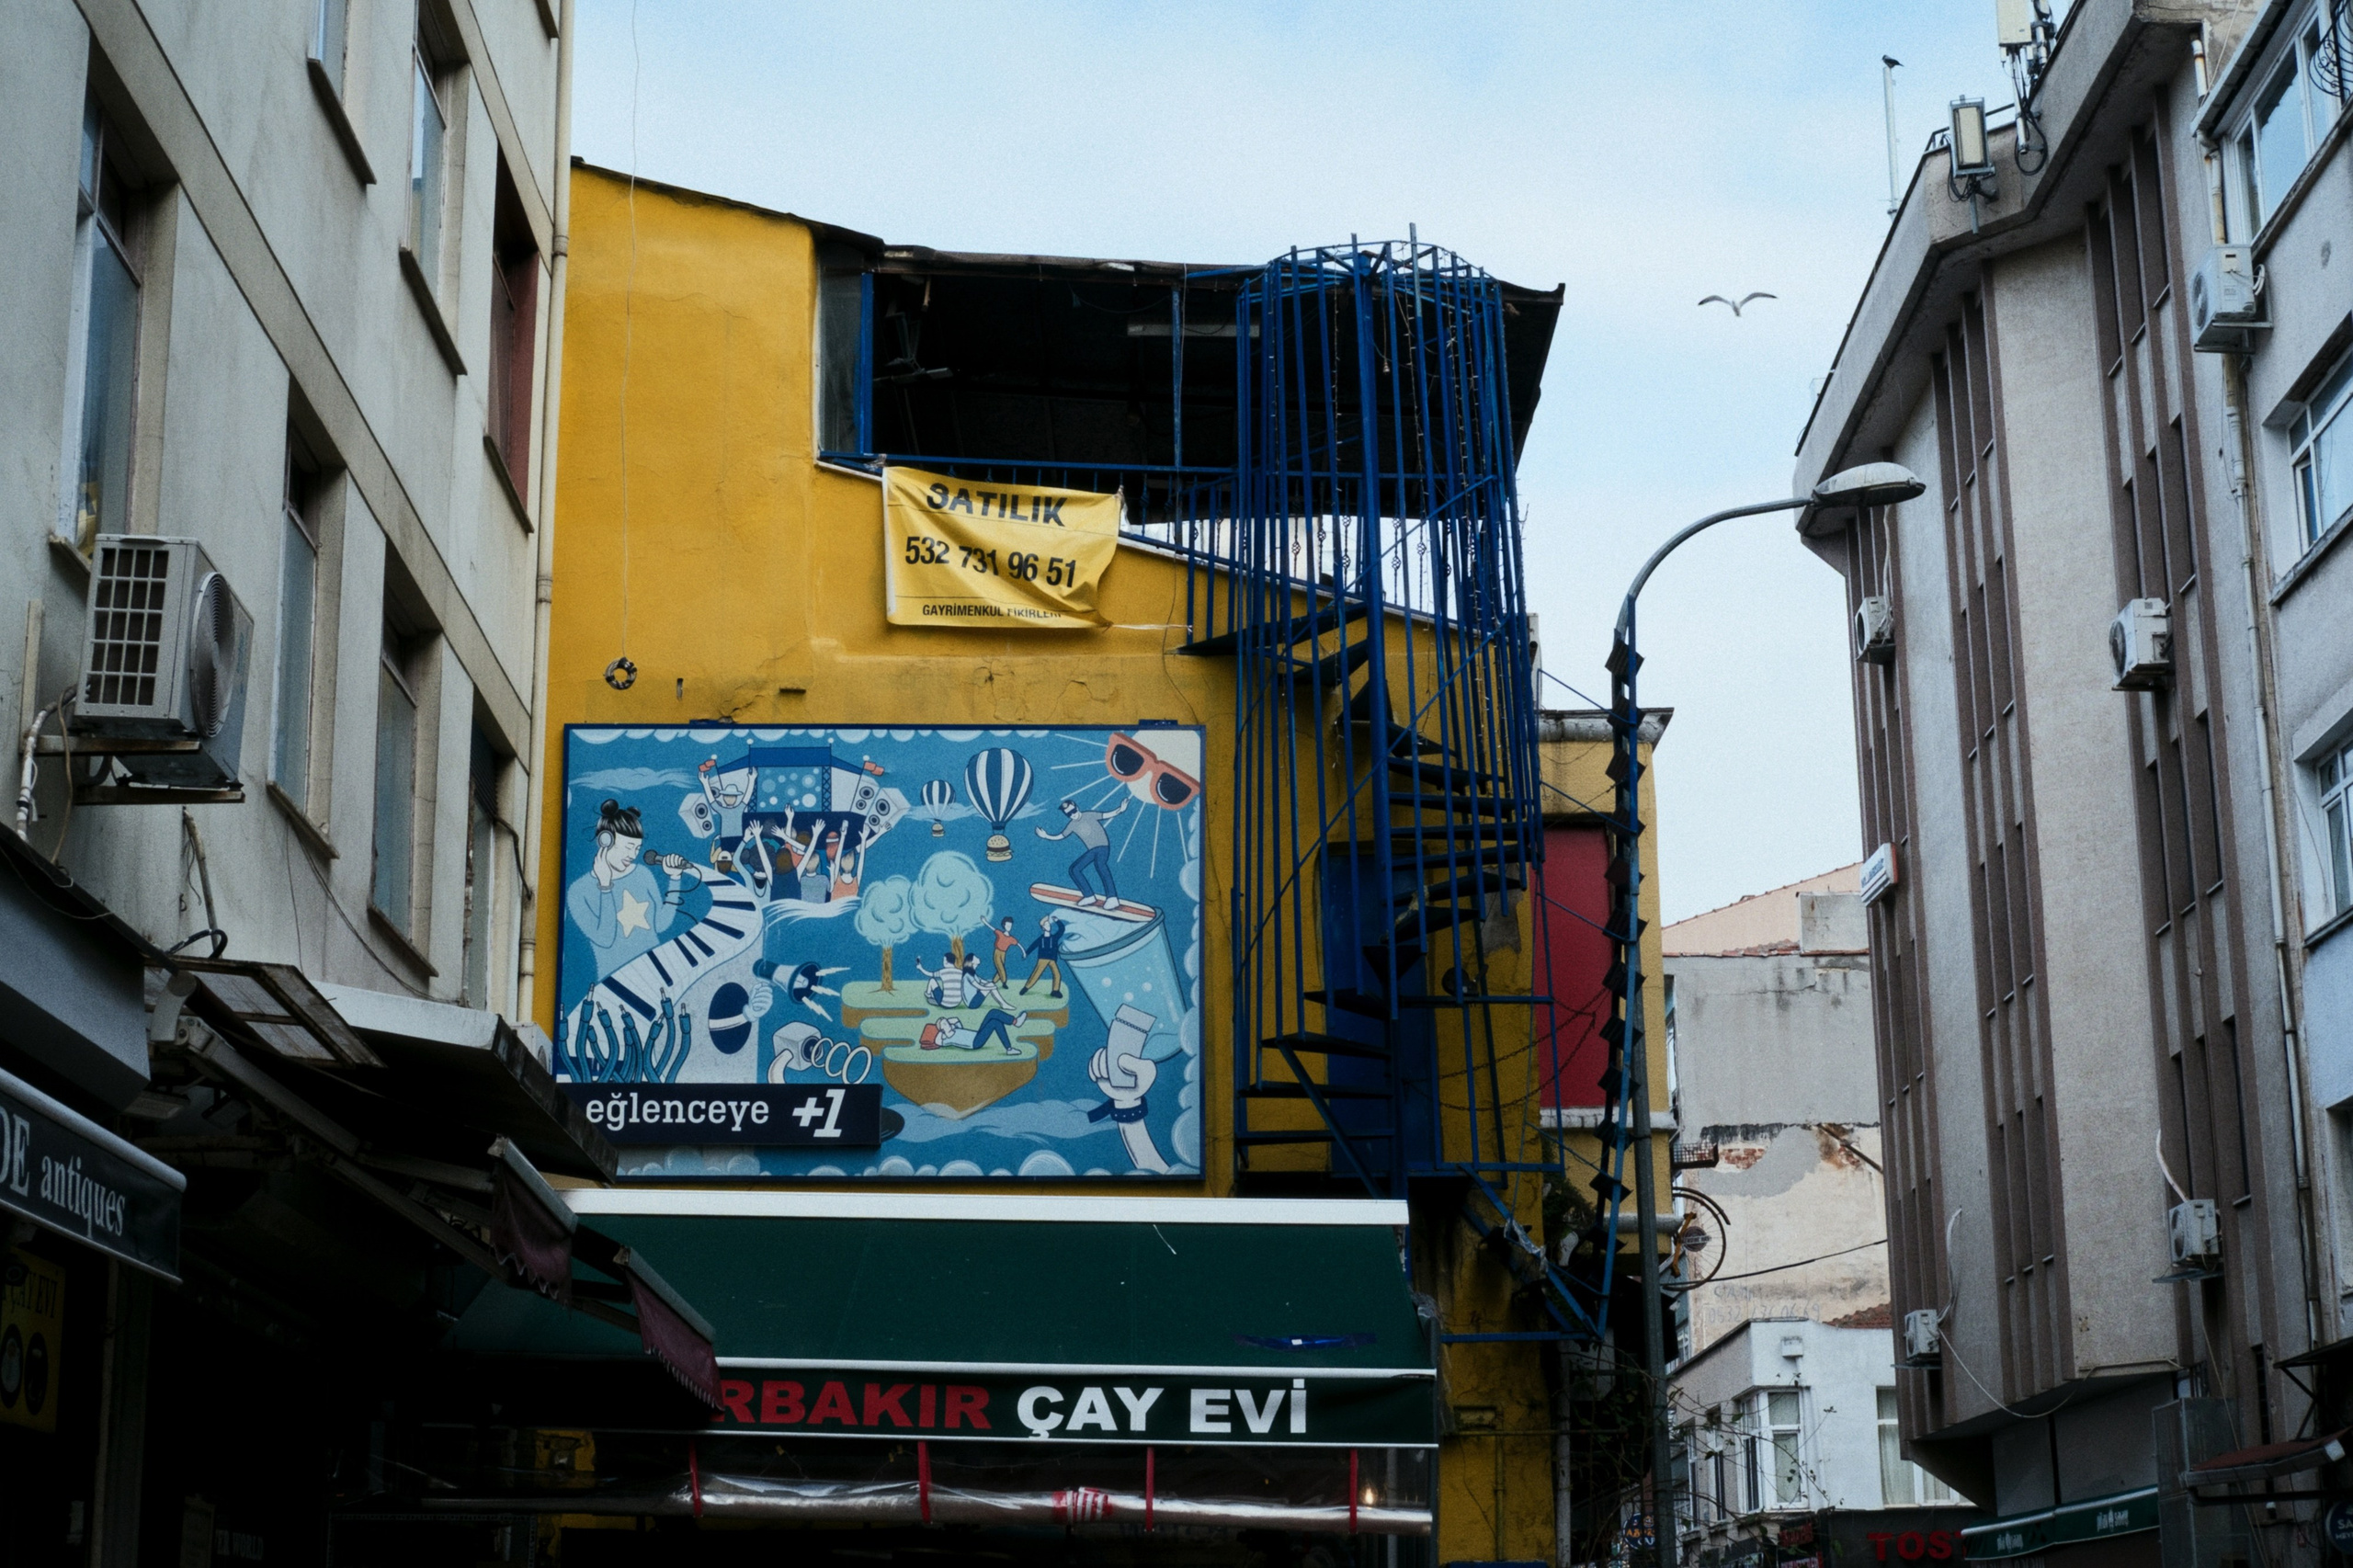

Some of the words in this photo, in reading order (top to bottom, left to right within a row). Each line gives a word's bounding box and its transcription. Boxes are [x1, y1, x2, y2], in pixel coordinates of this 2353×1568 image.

[926, 483, 1068, 527] SATILIK
[905, 537, 949, 564] 532
[959, 546, 999, 576] 731
[1007, 551, 1039, 582] 96
[1046, 557, 1076, 587] 51
[923, 603, 1004, 617] GAYRİMENKUL
[586, 1093, 769, 1131] eğlenceye
[792, 1088, 846, 1137] +1
[40, 1155, 125, 1239] antiques
[1017, 1385, 1165, 1439] ÇAY
[1190, 1379, 1306, 1434] EVİ
